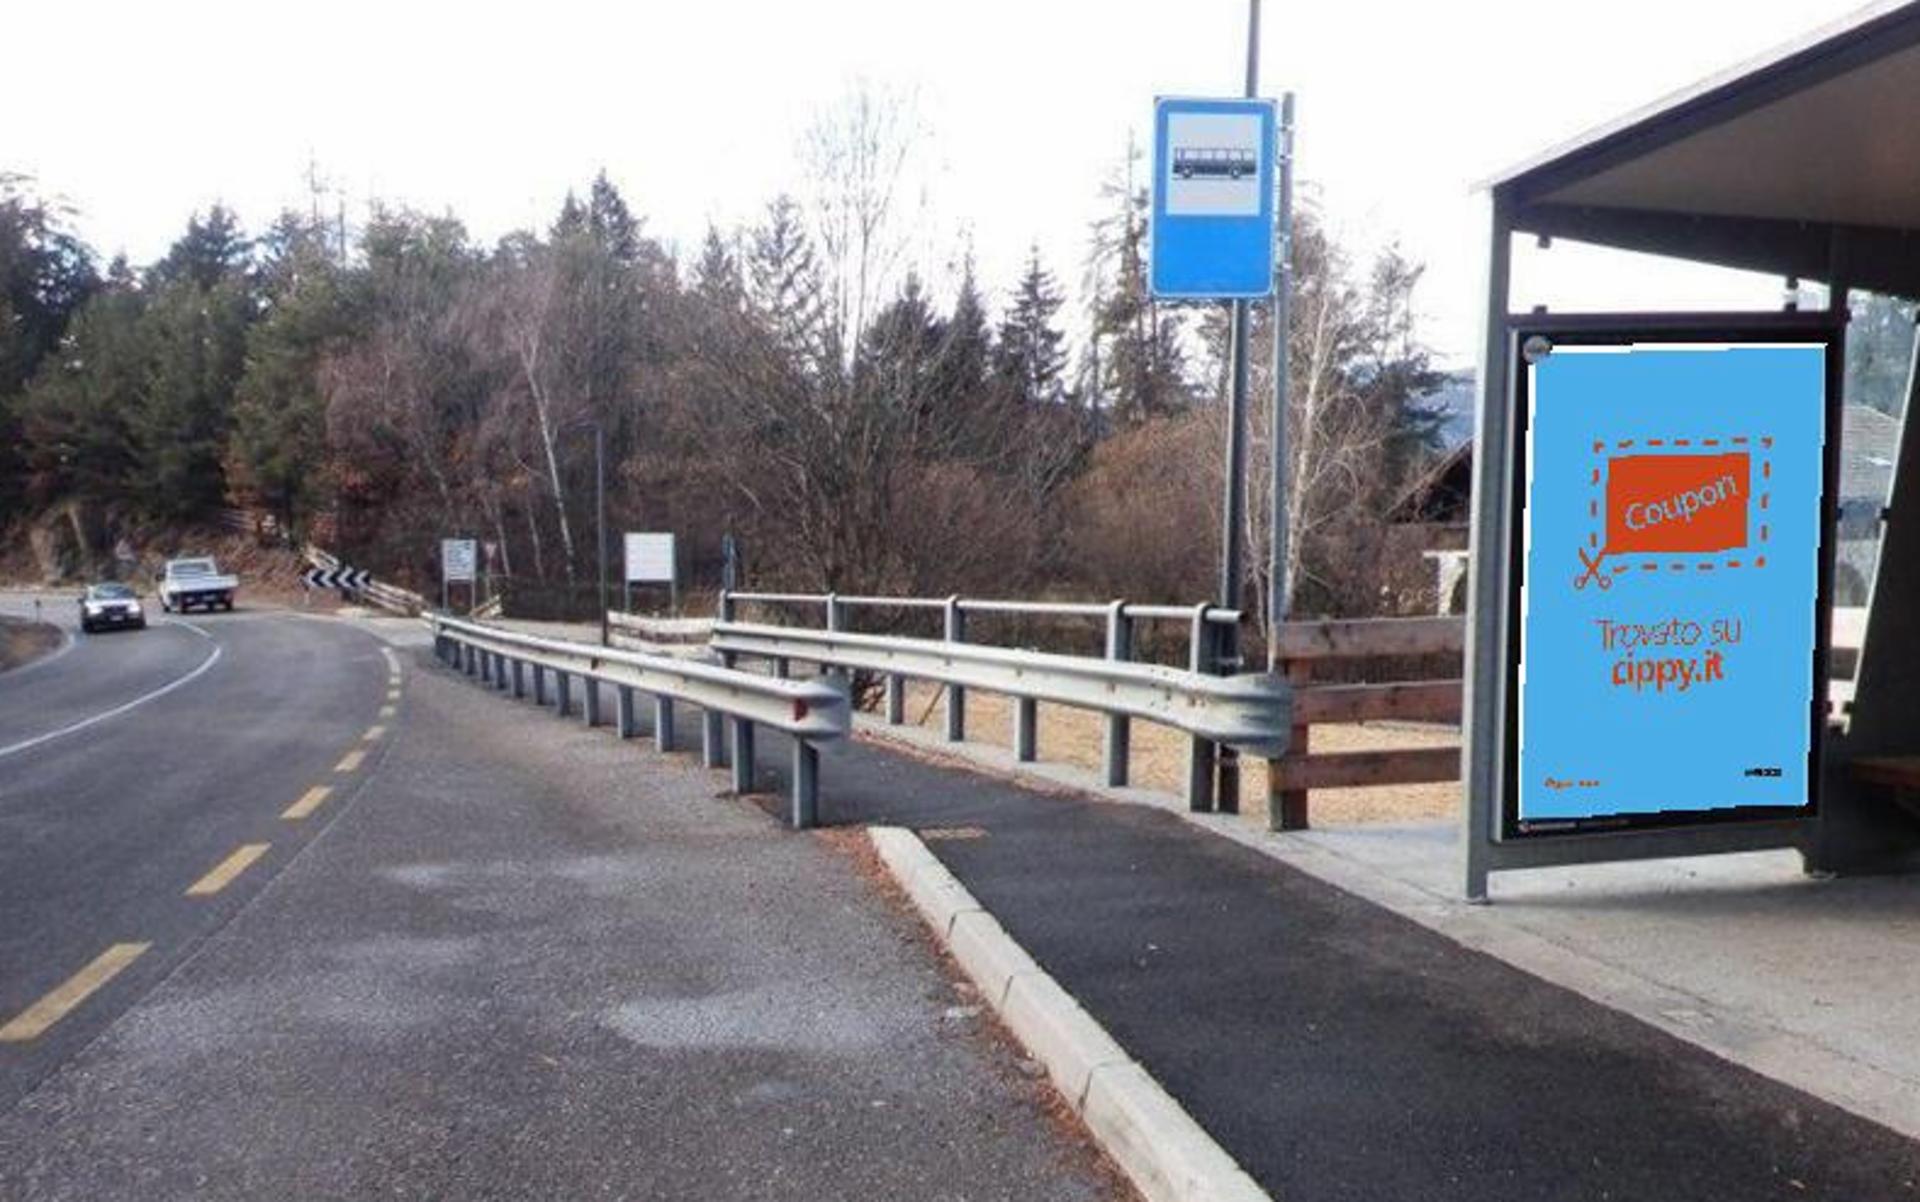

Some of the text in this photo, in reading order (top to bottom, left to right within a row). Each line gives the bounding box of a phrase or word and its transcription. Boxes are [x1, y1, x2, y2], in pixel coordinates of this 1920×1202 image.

[1625, 475, 1738, 531] Coupon
[1594, 617, 1701, 650] Trovato
[1612, 649, 1723, 692] cippy.it
